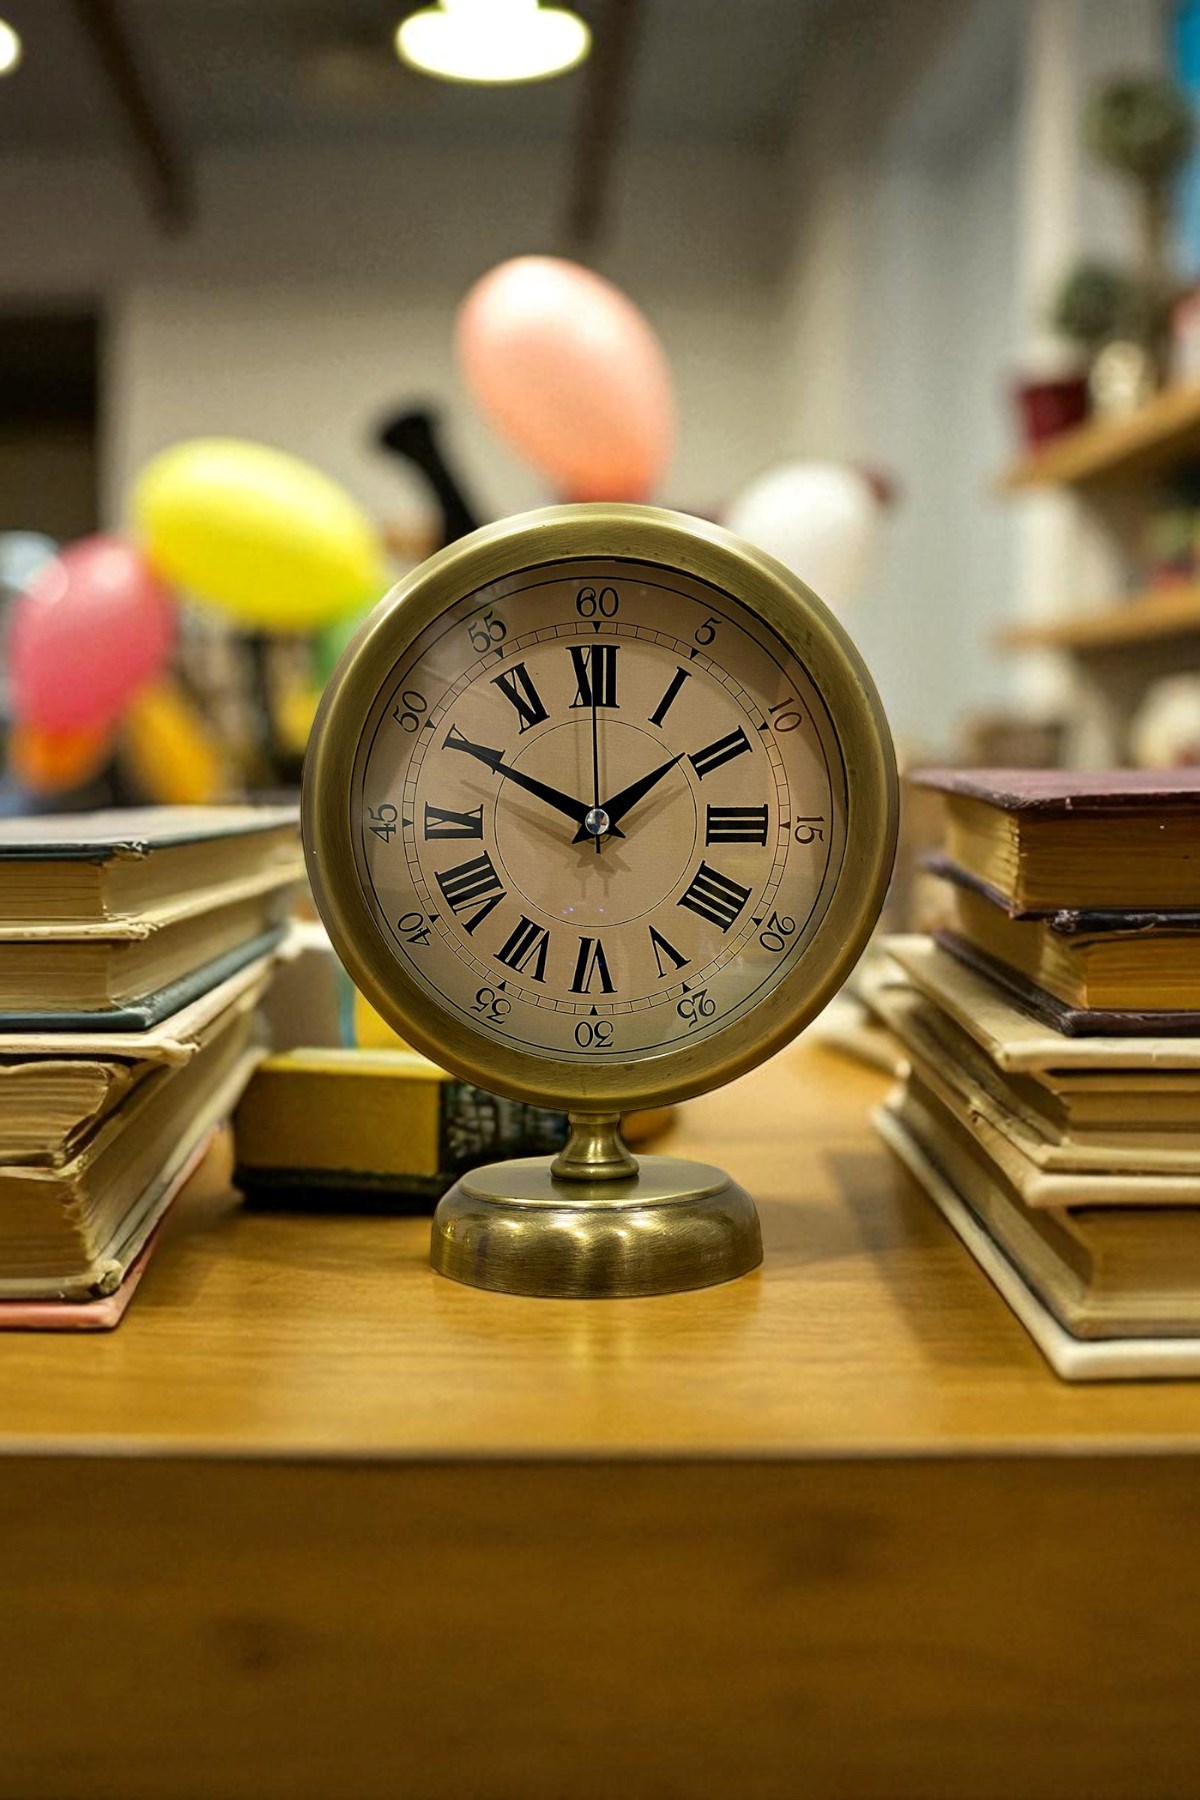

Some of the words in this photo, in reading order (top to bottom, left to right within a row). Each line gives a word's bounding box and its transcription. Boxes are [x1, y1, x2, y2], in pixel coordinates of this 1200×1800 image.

[576, 587, 619, 618] 60
[467, 610, 507, 653] 55
[694, 617, 723, 646] 5
[566, 644, 620, 708] XII
[648, 667, 692, 728] I
[393, 690, 428, 733] 50
[490, 662, 550, 734] XI
[767, 697, 803, 733] 10
[442, 723, 505, 774] X
[687, 726, 753, 780] II
[367, 804, 398, 843] 45
[424, 801, 483, 840] IX
[706, 804, 769, 847] III
[794, 815, 825, 845] 15
[434, 850, 507, 936] VIII
[676, 860, 752, 933] IIII
[397, 912, 431, 948] 40
[493, 915, 552, 983] VII
[648, 924, 691, 978] V
[759, 911, 797, 953] 20
[568, 936, 617, 994] VI
[470, 987, 513, 1023] 35
[676, 989, 716, 1027] 25
[574, 1021, 614, 1048] 30
